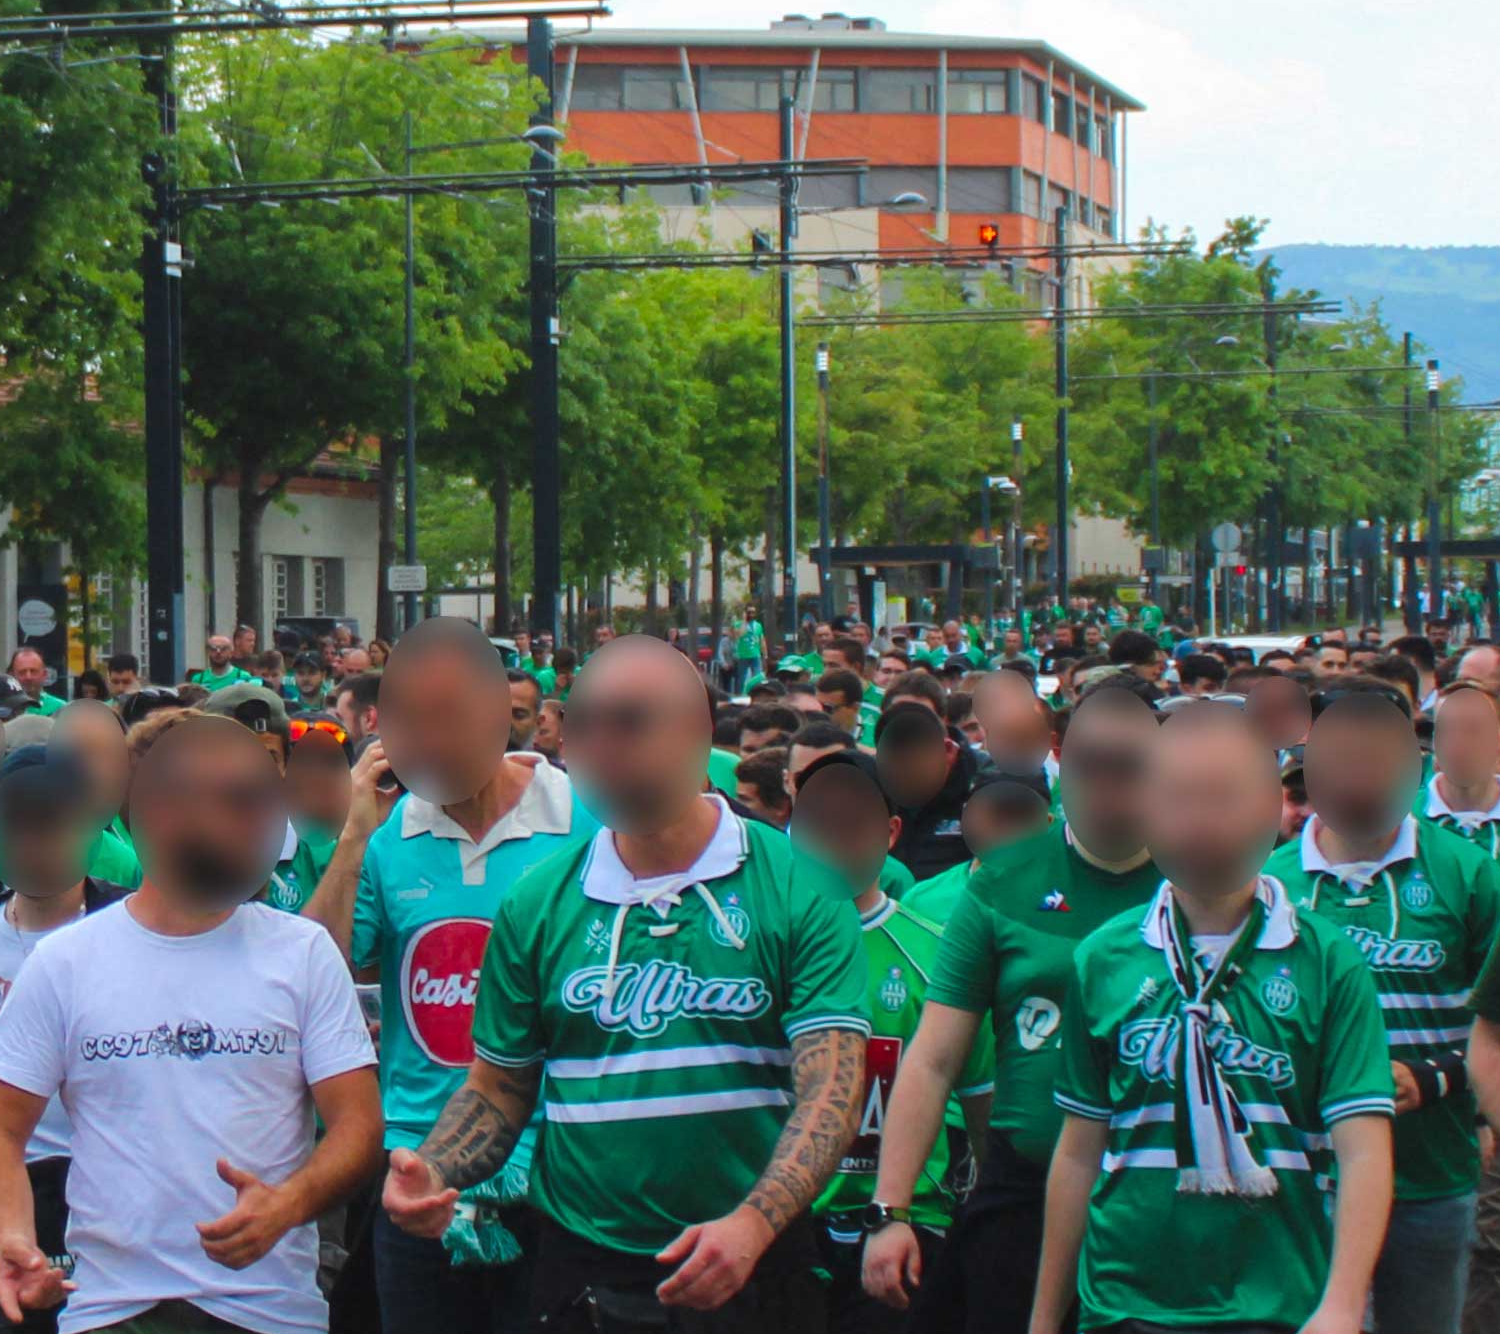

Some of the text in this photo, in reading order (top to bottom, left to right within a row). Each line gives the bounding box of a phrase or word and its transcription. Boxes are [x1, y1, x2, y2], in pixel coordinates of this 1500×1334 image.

[411, 968, 481, 1008] Casi
[562, 959, 772, 1039] Ultras
[81, 1028, 287, 1061] CC97 MF91
